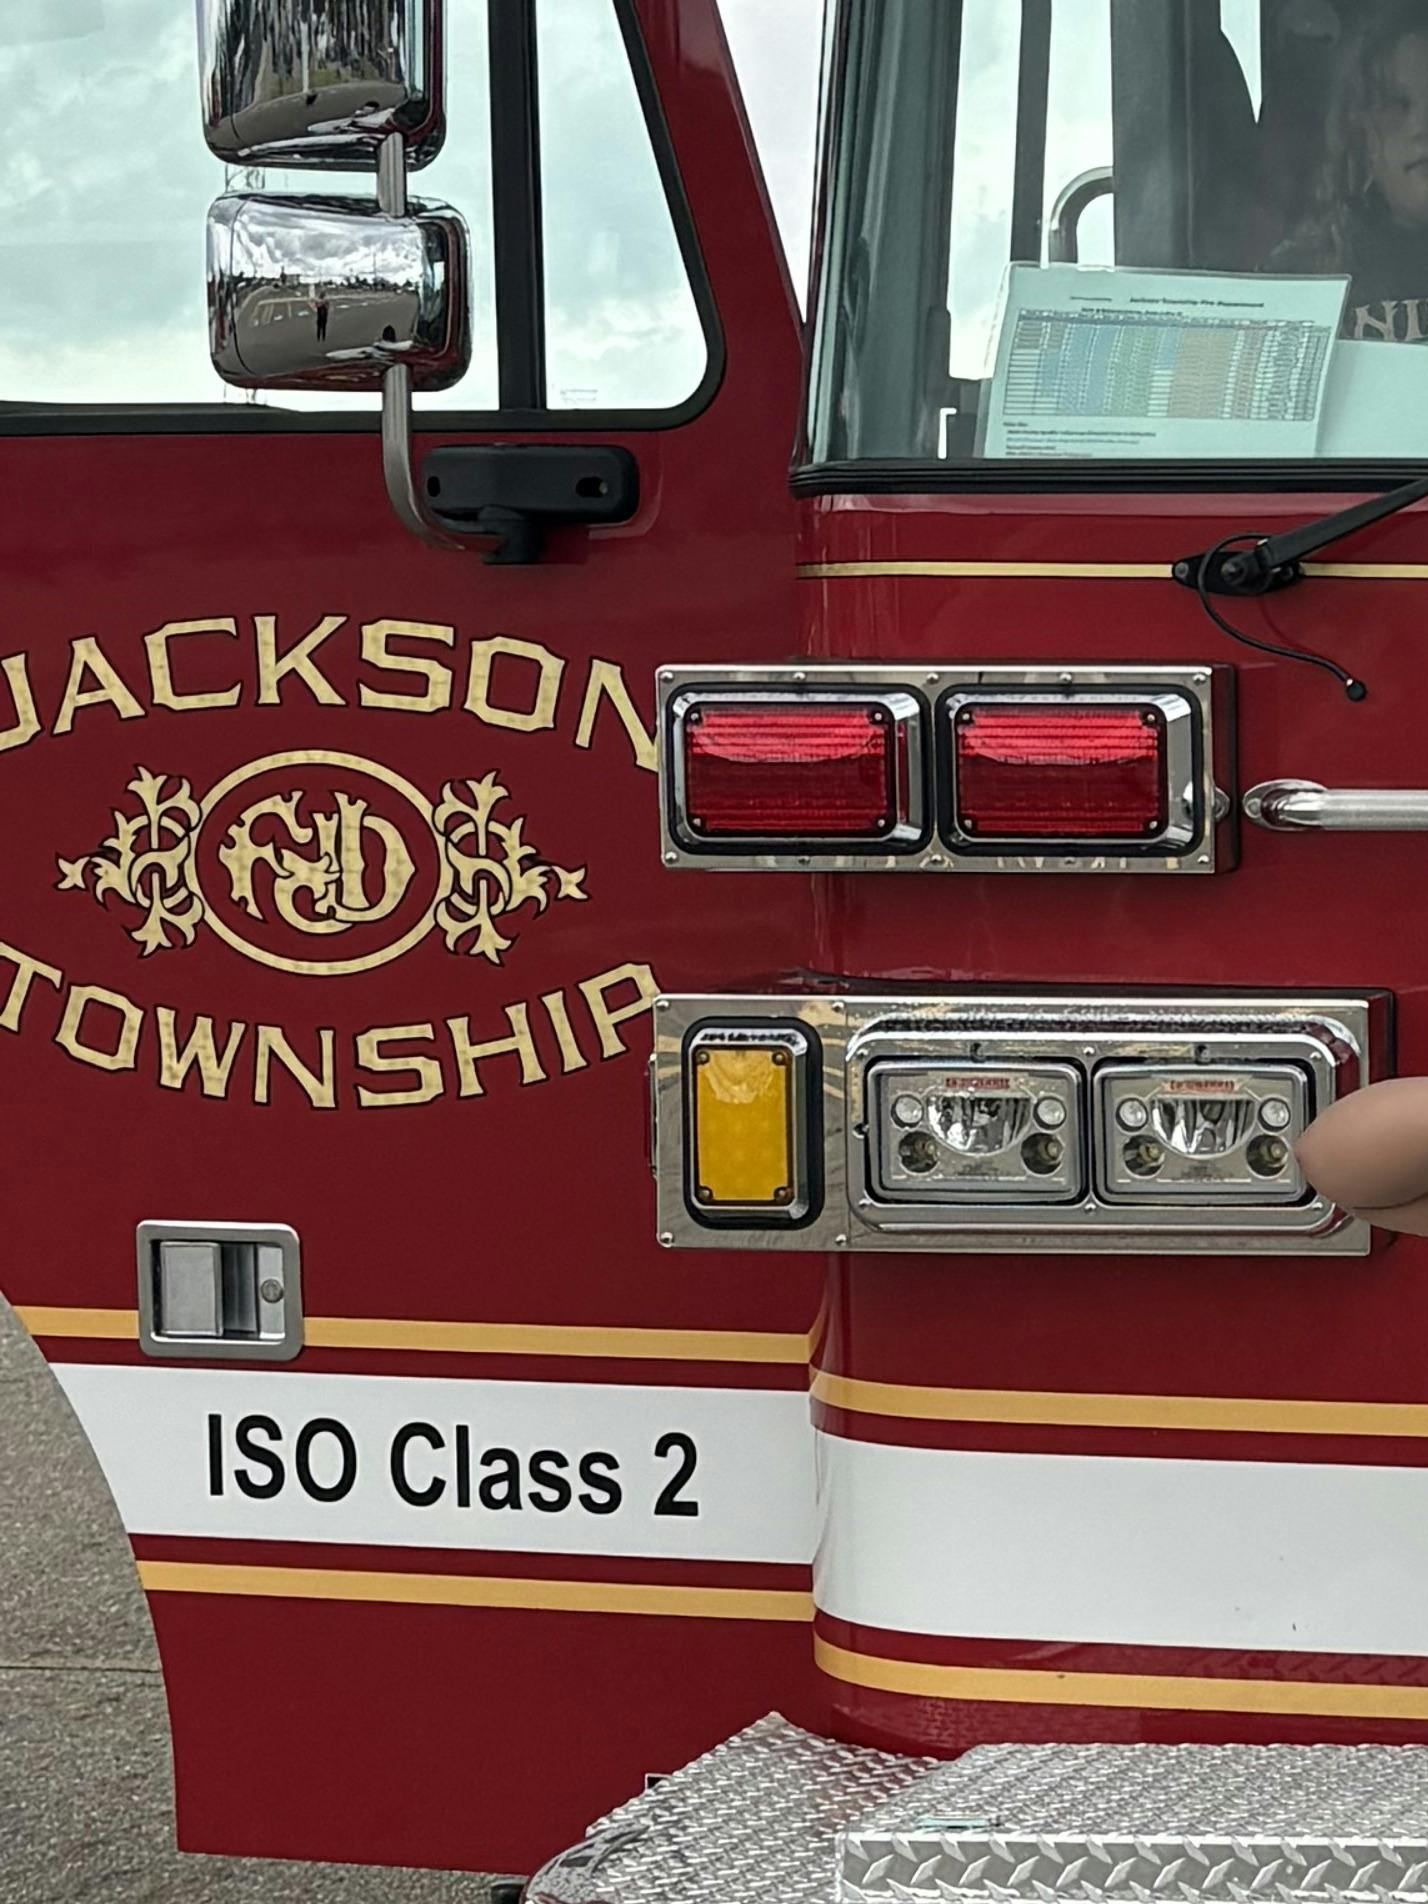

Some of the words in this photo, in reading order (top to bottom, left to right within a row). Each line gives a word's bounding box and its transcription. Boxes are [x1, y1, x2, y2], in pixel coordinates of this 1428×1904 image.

[0, 614, 660, 774] JACKSON
[0, 940, 662, 1110] TOWNSHIP
[207, 1412, 358, 1504] ISO
[389, 1420, 623, 1516] Class
[653, 1431, 700, 1518] 2
